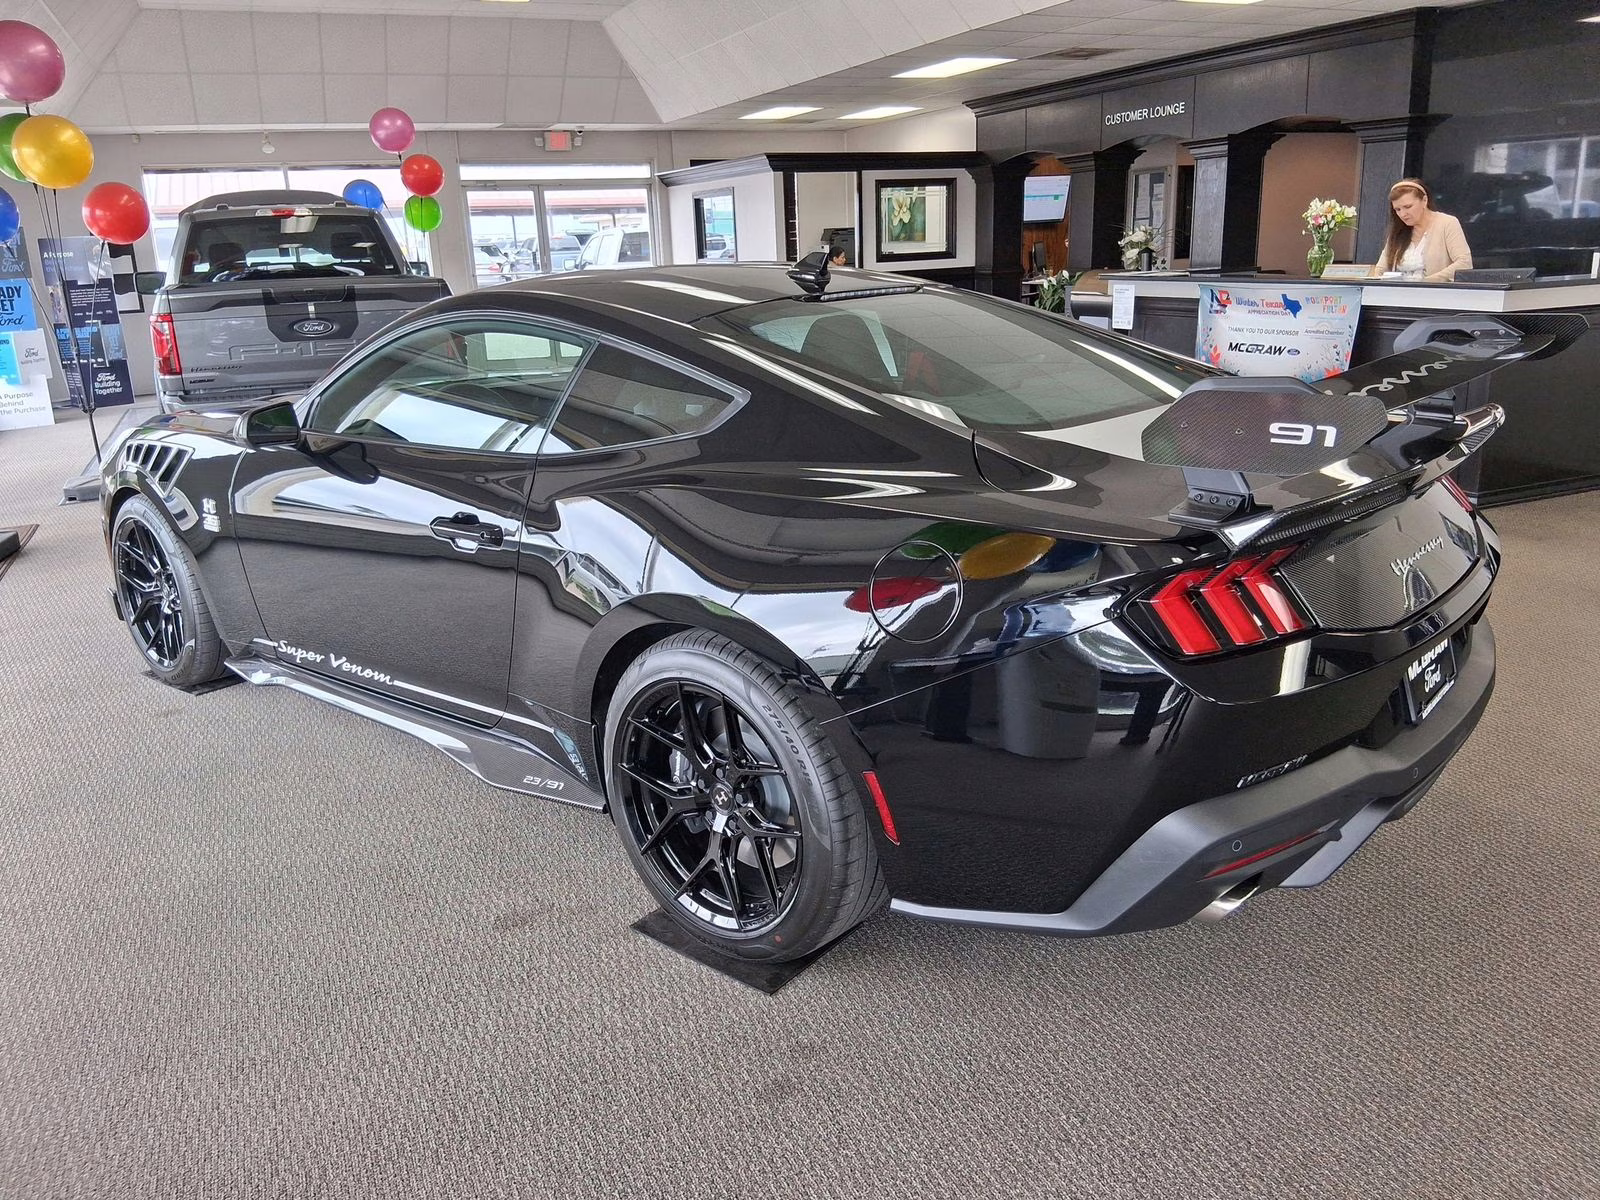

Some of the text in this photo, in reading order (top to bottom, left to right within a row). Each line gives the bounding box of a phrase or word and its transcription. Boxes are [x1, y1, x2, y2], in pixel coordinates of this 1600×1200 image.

[1105, 102, 1186, 125] CUSTOMER LOUNGE
[0, 286, 21, 298] ADY
[0, 299, 14, 311] ET
[302, 322, 325, 332] Ford
[1276, 329, 1300, 337] SPONSOR
[1228, 341, 1287, 356] MCGRAW
[96, 372, 117, 382] Ford
[94, 381, 121, 389] Building
[94, 387, 123, 395] Together
[14, 405, 46, 415] Purchase
[1269, 421, 1337, 448] 91
[277, 639, 394, 685] Super Venom
[1424, 663, 1442, 693] Ford
[523, 775, 565, 791] 23/91
